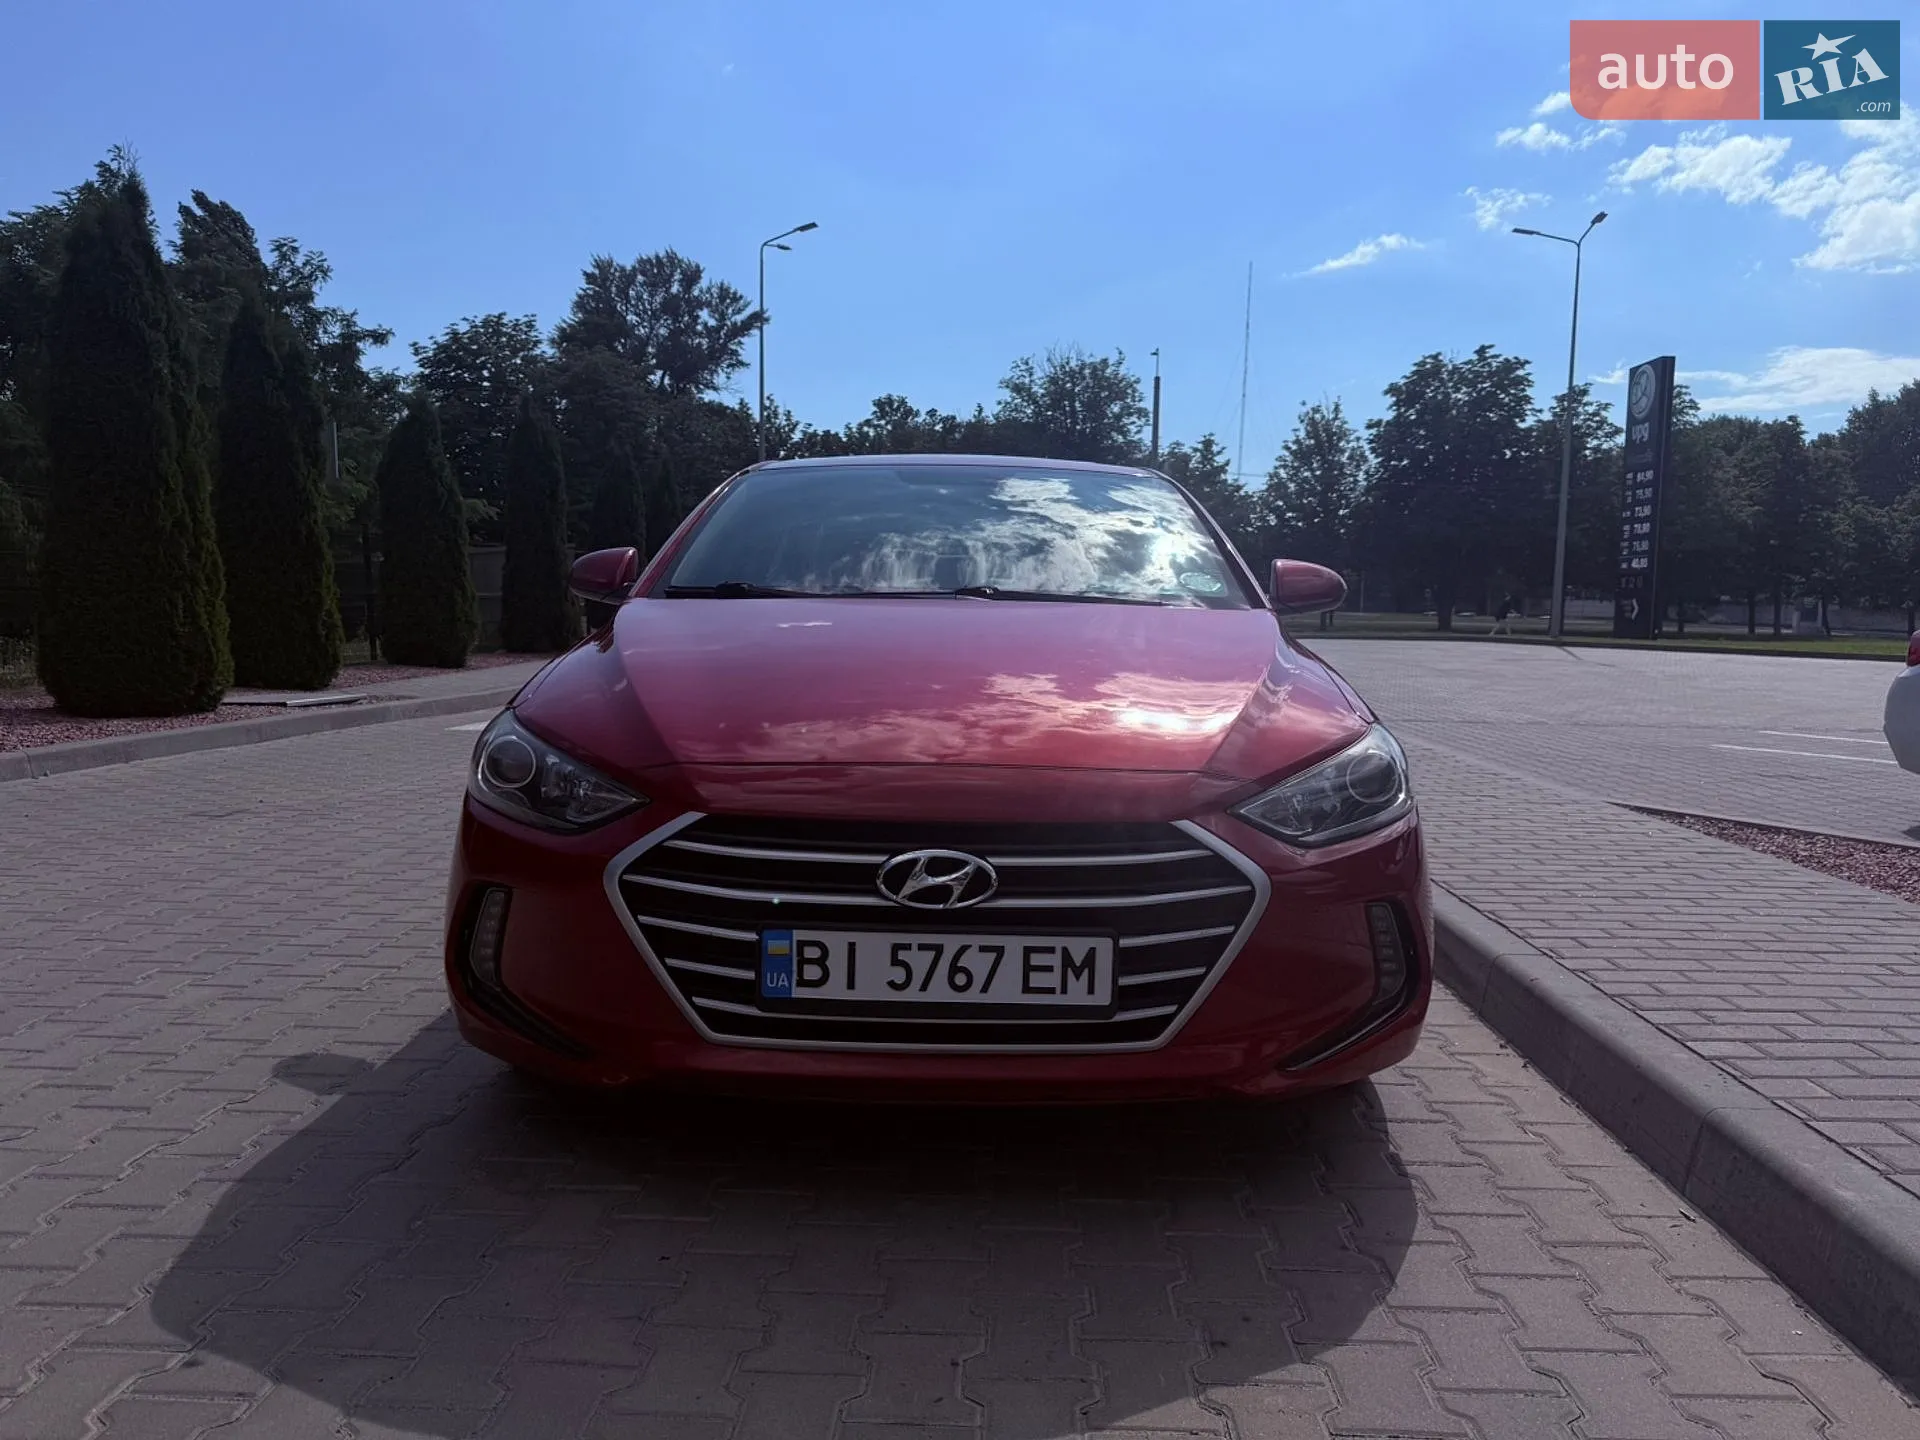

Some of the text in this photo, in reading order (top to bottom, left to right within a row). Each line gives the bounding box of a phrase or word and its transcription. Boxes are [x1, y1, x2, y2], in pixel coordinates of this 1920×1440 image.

[766, 972, 789, 988] UA
[796, 940, 1096, 995] BI 5767 EM
